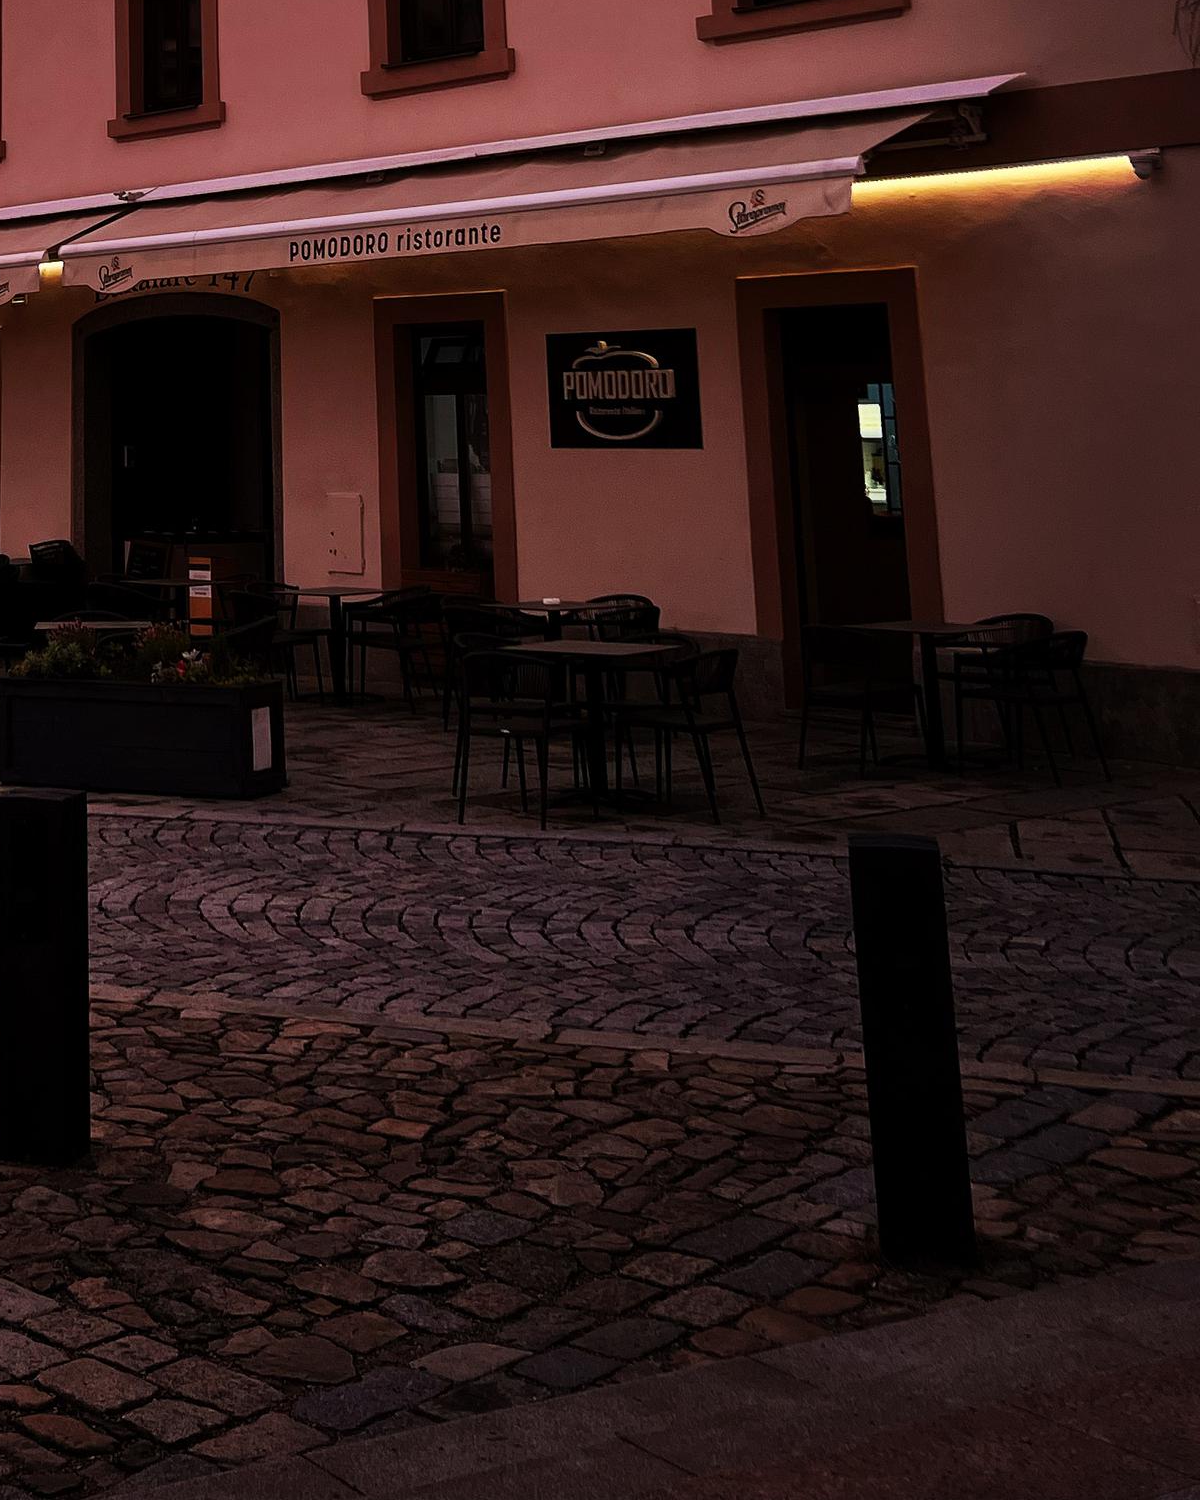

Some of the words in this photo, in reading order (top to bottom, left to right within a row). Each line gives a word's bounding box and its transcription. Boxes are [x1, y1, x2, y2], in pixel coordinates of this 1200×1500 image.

[289, 232, 389, 262] POMODORO
[397, 223, 501, 252] ristorante
[562, 368, 677, 400] POMODORO
